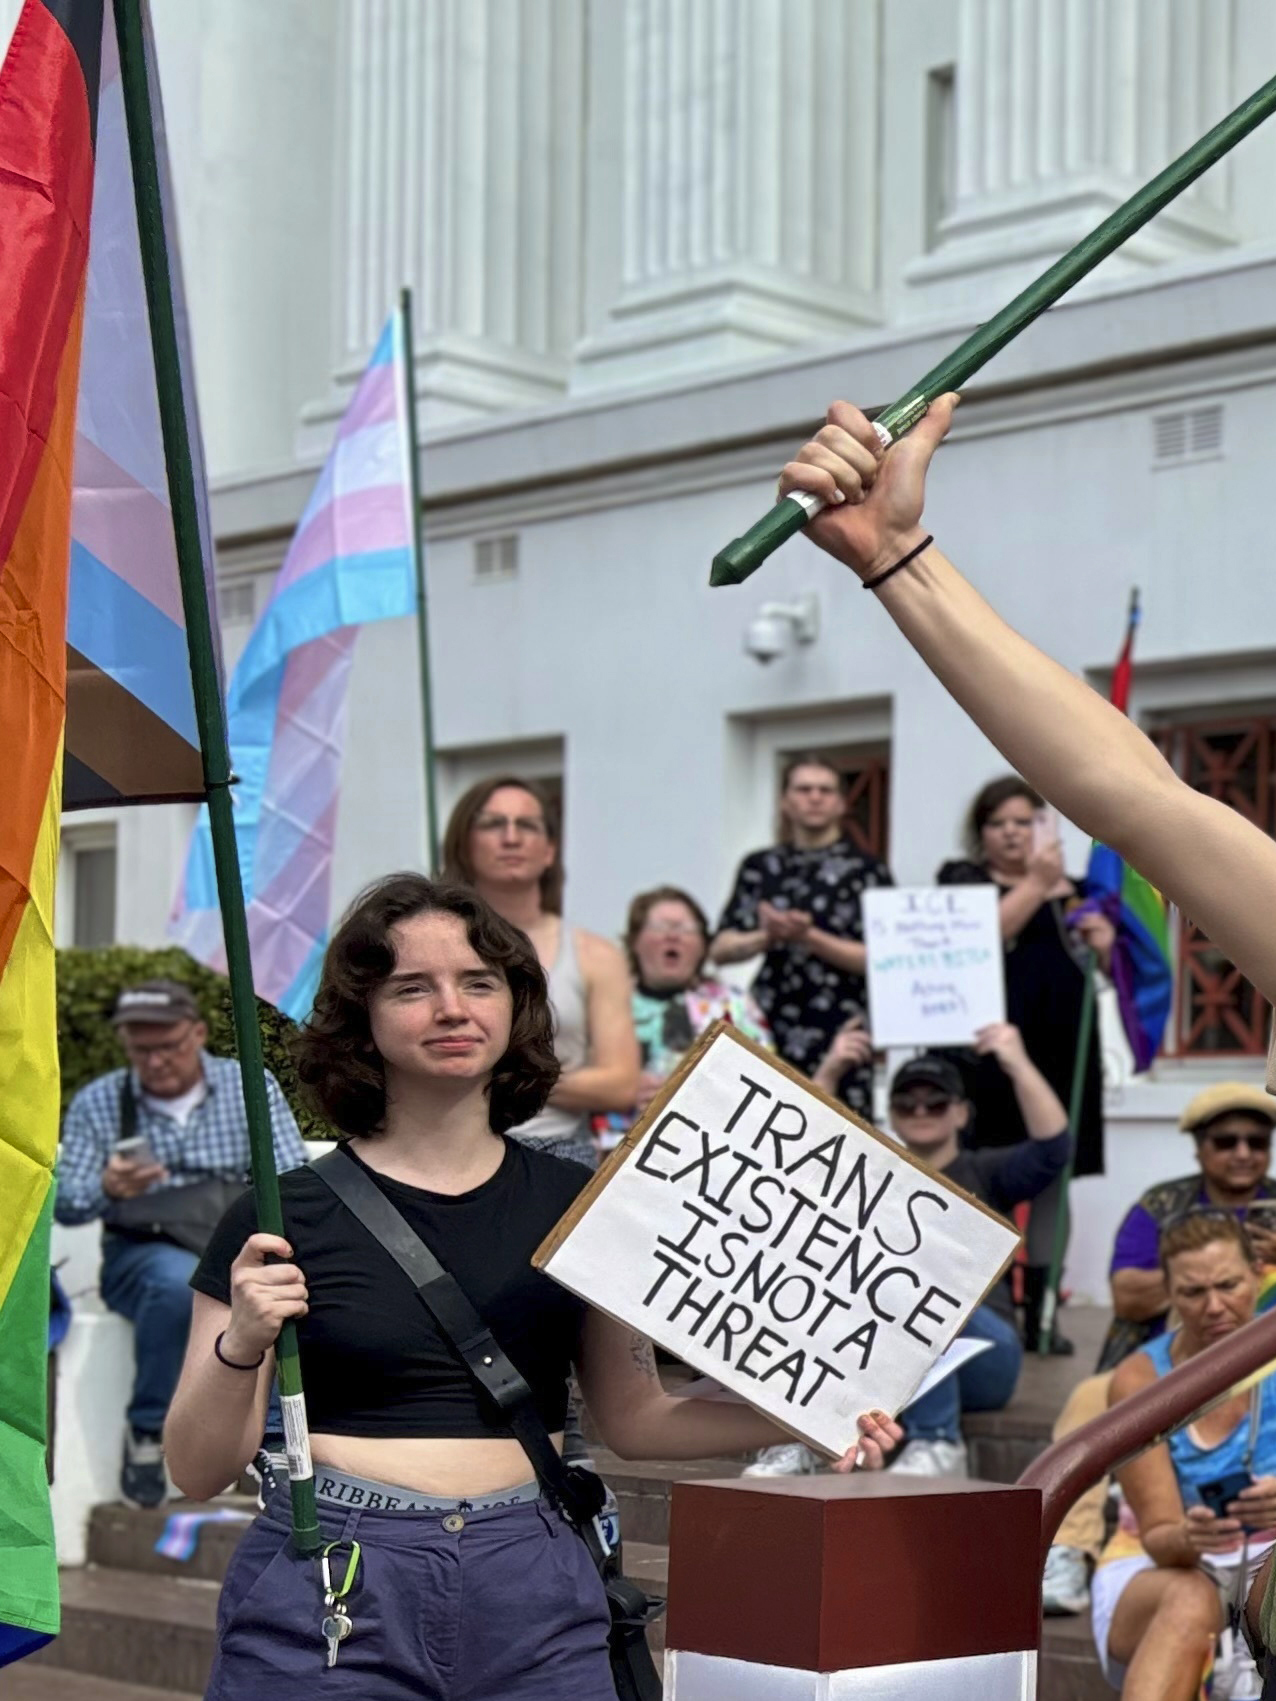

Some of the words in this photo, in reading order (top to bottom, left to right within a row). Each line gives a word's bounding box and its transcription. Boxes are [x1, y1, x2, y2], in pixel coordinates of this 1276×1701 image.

[634, 1111, 962, 1348] EXISTENCE
[723, 1073, 949, 1257] TRANS
[642, 1249, 846, 1407] THREAT
